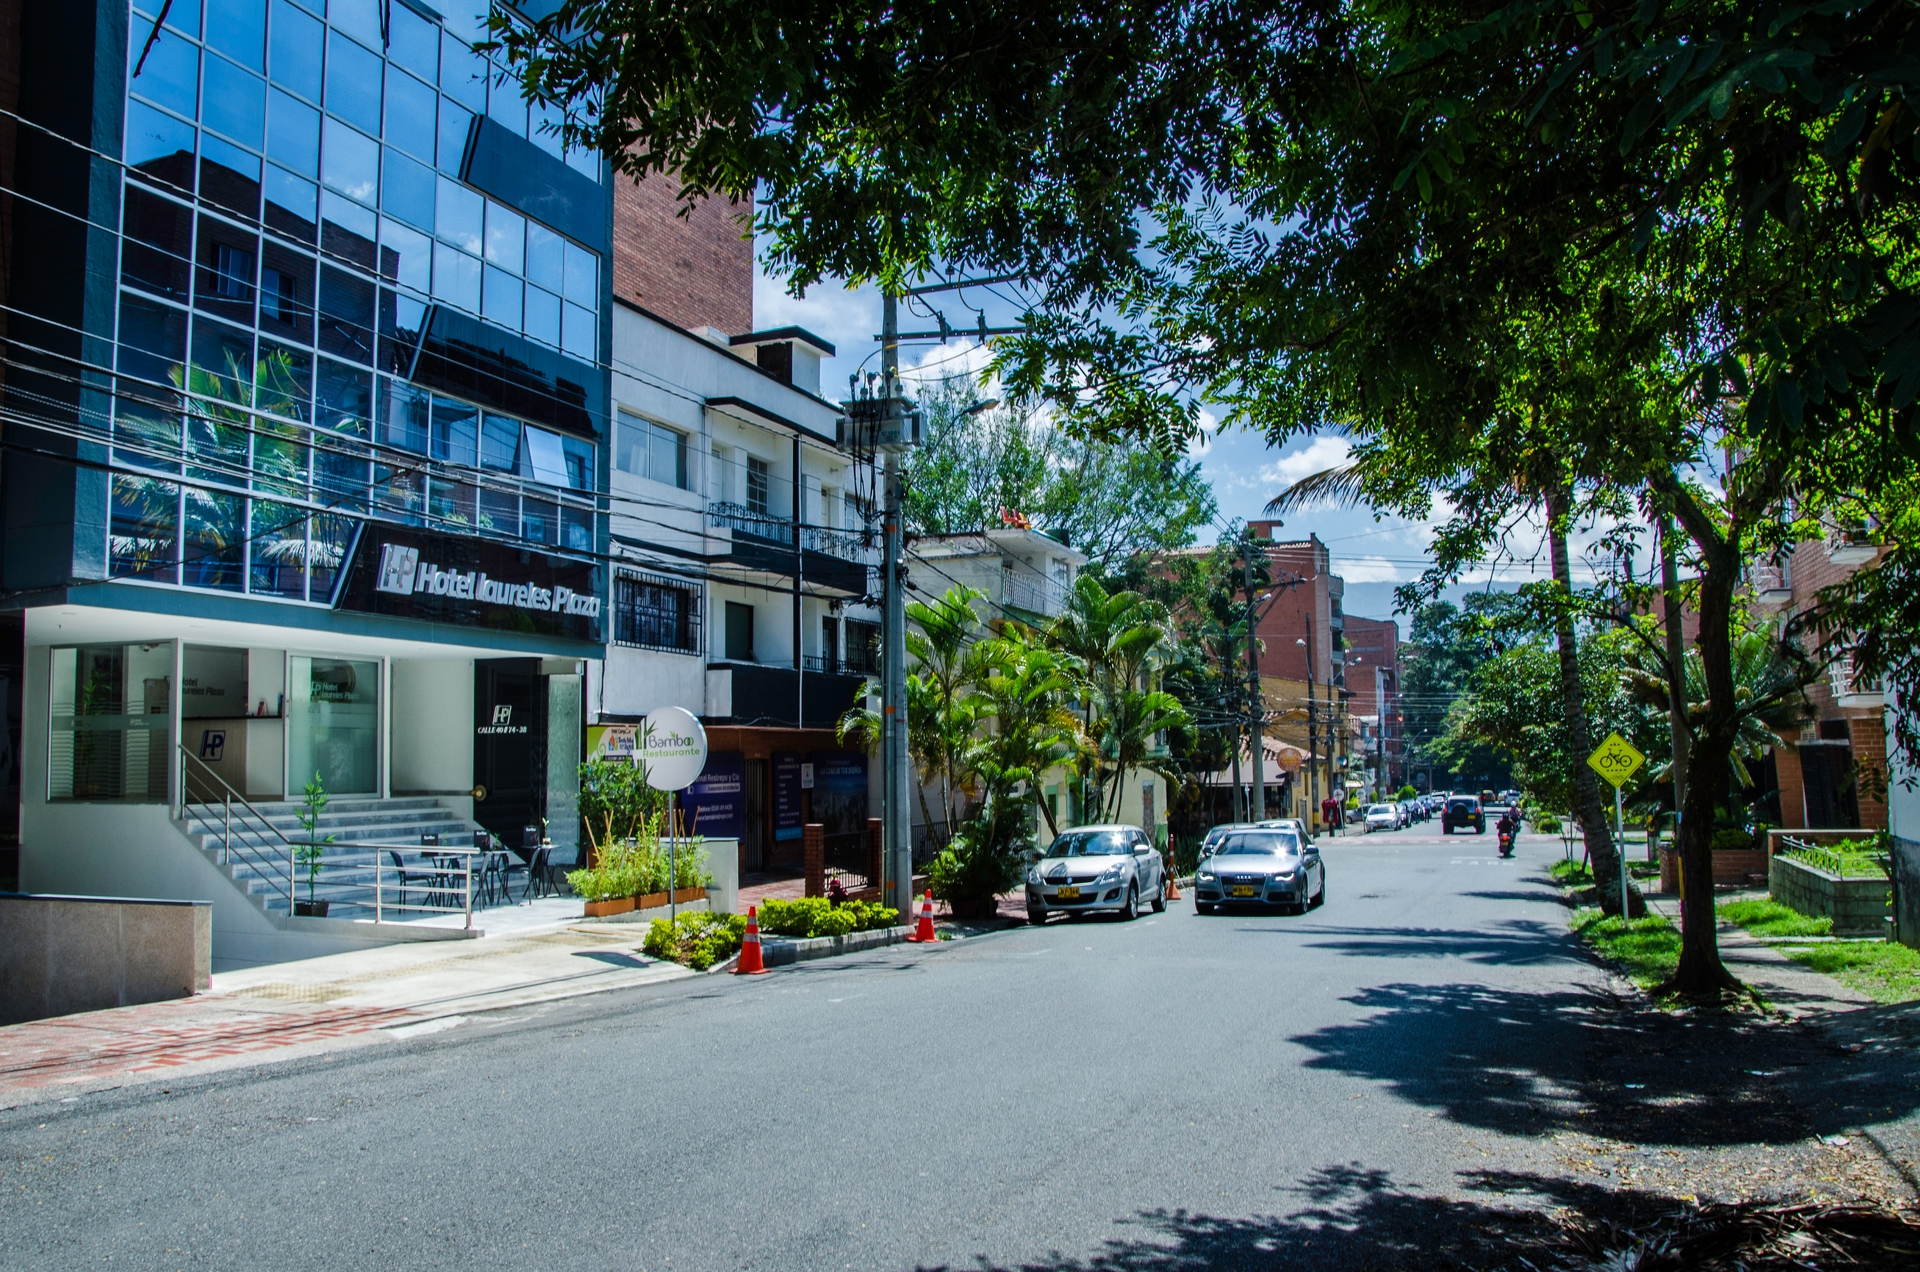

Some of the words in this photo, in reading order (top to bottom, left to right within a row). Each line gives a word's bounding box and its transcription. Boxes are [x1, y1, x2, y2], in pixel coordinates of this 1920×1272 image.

[415, 562, 476, 600] Hotel
[551, 585, 600, 618] Plaza
[322, 682, 338, 691] Hotel
[206, 687, 225, 696] Plaza
[477, 726, 496, 734] CALLE
[648, 734, 695, 748] Bamboo
[643, 748, 700, 758] Restaurante
[707, 774, 728, 783] Restrepo
